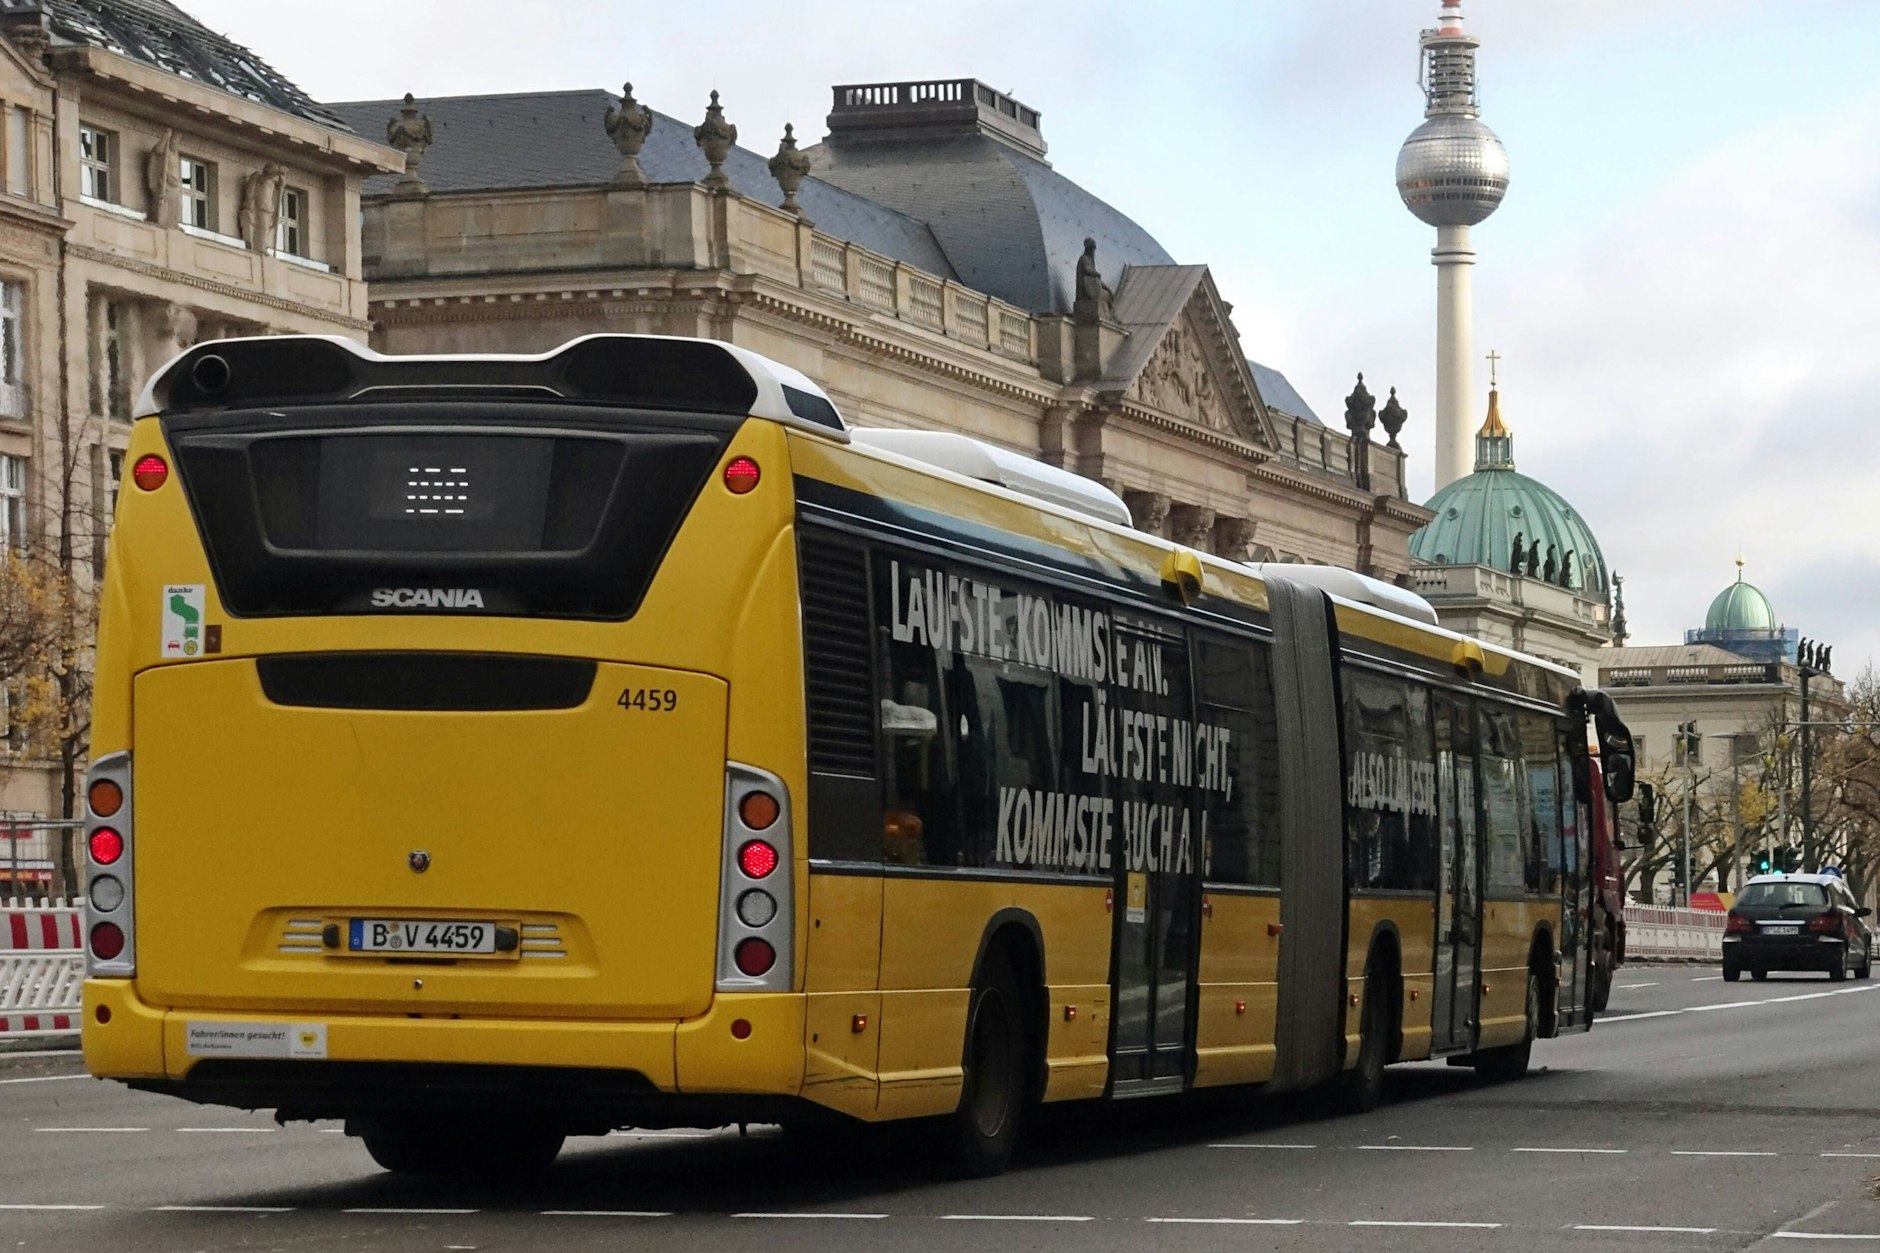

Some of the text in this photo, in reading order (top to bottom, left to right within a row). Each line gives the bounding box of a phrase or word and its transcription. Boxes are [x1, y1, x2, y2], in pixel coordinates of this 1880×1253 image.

[371, 588, 485, 609] SCANIA
[1017, 593, 1129, 688] KOMMSTE
[617, 688, 678, 711] 4459
[996, 786, 1113, 869] KOMMSTE
[372, 924, 484, 949] B V 4459
